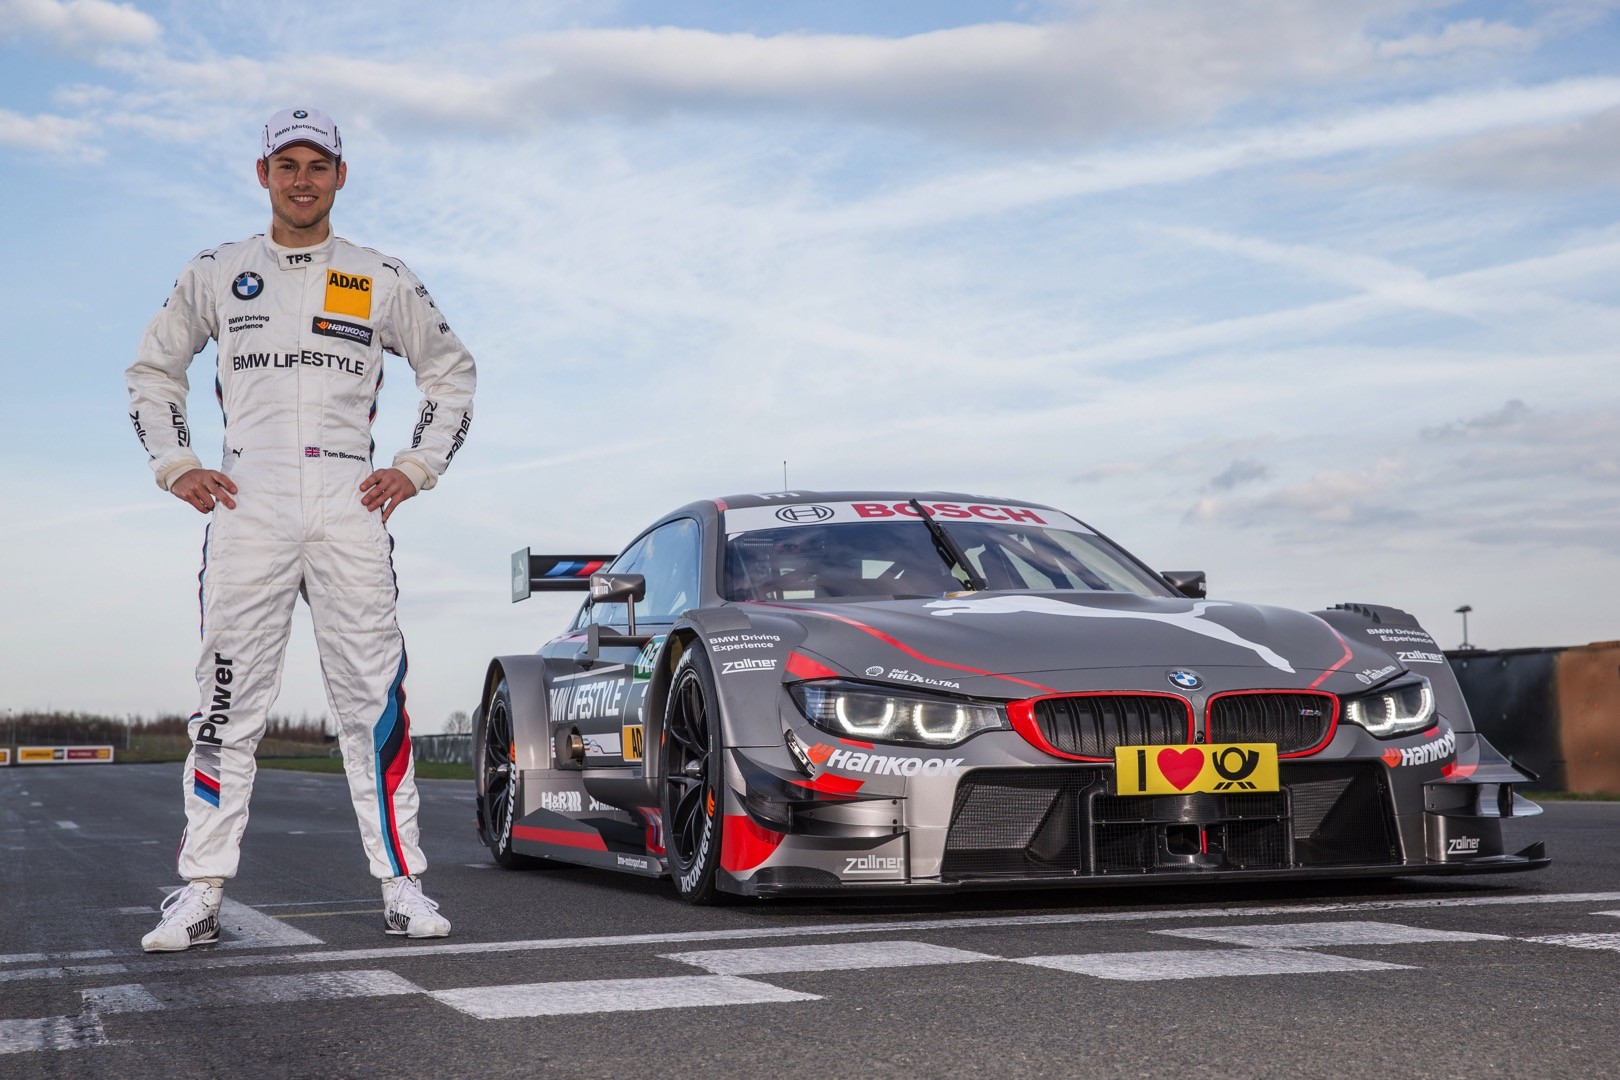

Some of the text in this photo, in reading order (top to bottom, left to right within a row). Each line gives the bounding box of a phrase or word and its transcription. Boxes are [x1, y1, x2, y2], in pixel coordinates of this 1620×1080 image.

[274, 124, 328, 138] BMW Motorsport
[286, 253, 312, 264] TPS
[328, 273, 370, 291] ADAC
[228, 316, 244, 325] BMW
[229, 323, 264, 332] Experience
[233, 350, 365, 376] BMW LIFESTYLE
[851, 503, 1049, 525] BOSCH
[709, 634, 780, 645] BMW Driving
[1380, 635, 1434, 644] Experience
[1394, 629, 1430, 638] Driving
[712, 642, 774, 652] Experience
[887, 672, 960, 689] HELIX ULTRA
[196, 652, 234, 746] Power
[568, 678, 626, 720] LIFESTYLE
[1137, 749, 1147, 792] I
[186, 915, 214, 941] PUMA
